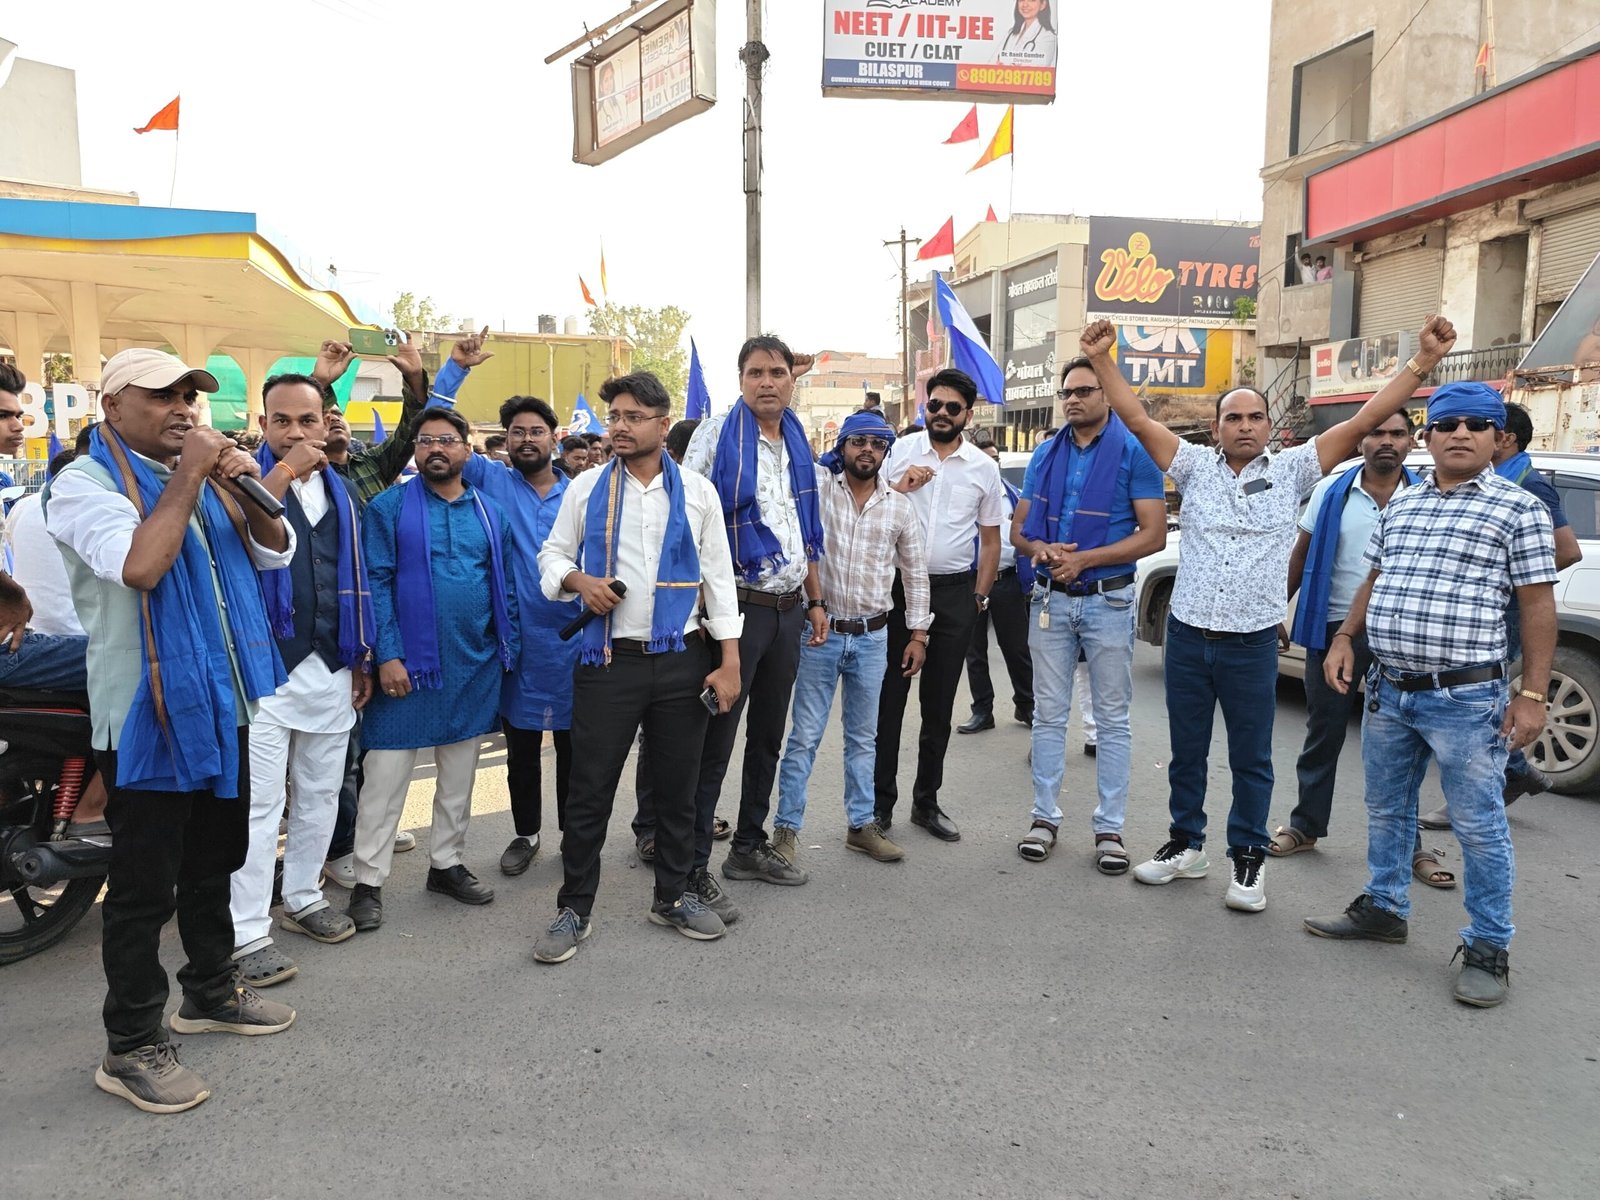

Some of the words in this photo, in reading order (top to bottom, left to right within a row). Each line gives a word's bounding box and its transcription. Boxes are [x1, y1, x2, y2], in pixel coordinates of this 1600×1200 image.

[834, 10, 893, 36] NEET
[898, 13, 912, 37] /
[917, 14, 994, 40] IIT-JEE
[865, 42, 906, 58] CUET
[910, 43, 919, 59] /
[923, 44, 962, 60] CLAT
[858, 62, 923, 78] BILASPUR
[970, 68, 1052, 86] 8902987789
[1178, 261, 1257, 289] TYRES
[1125, 357, 1196, 384] TMT
[1317, 359, 1331, 368] cello
